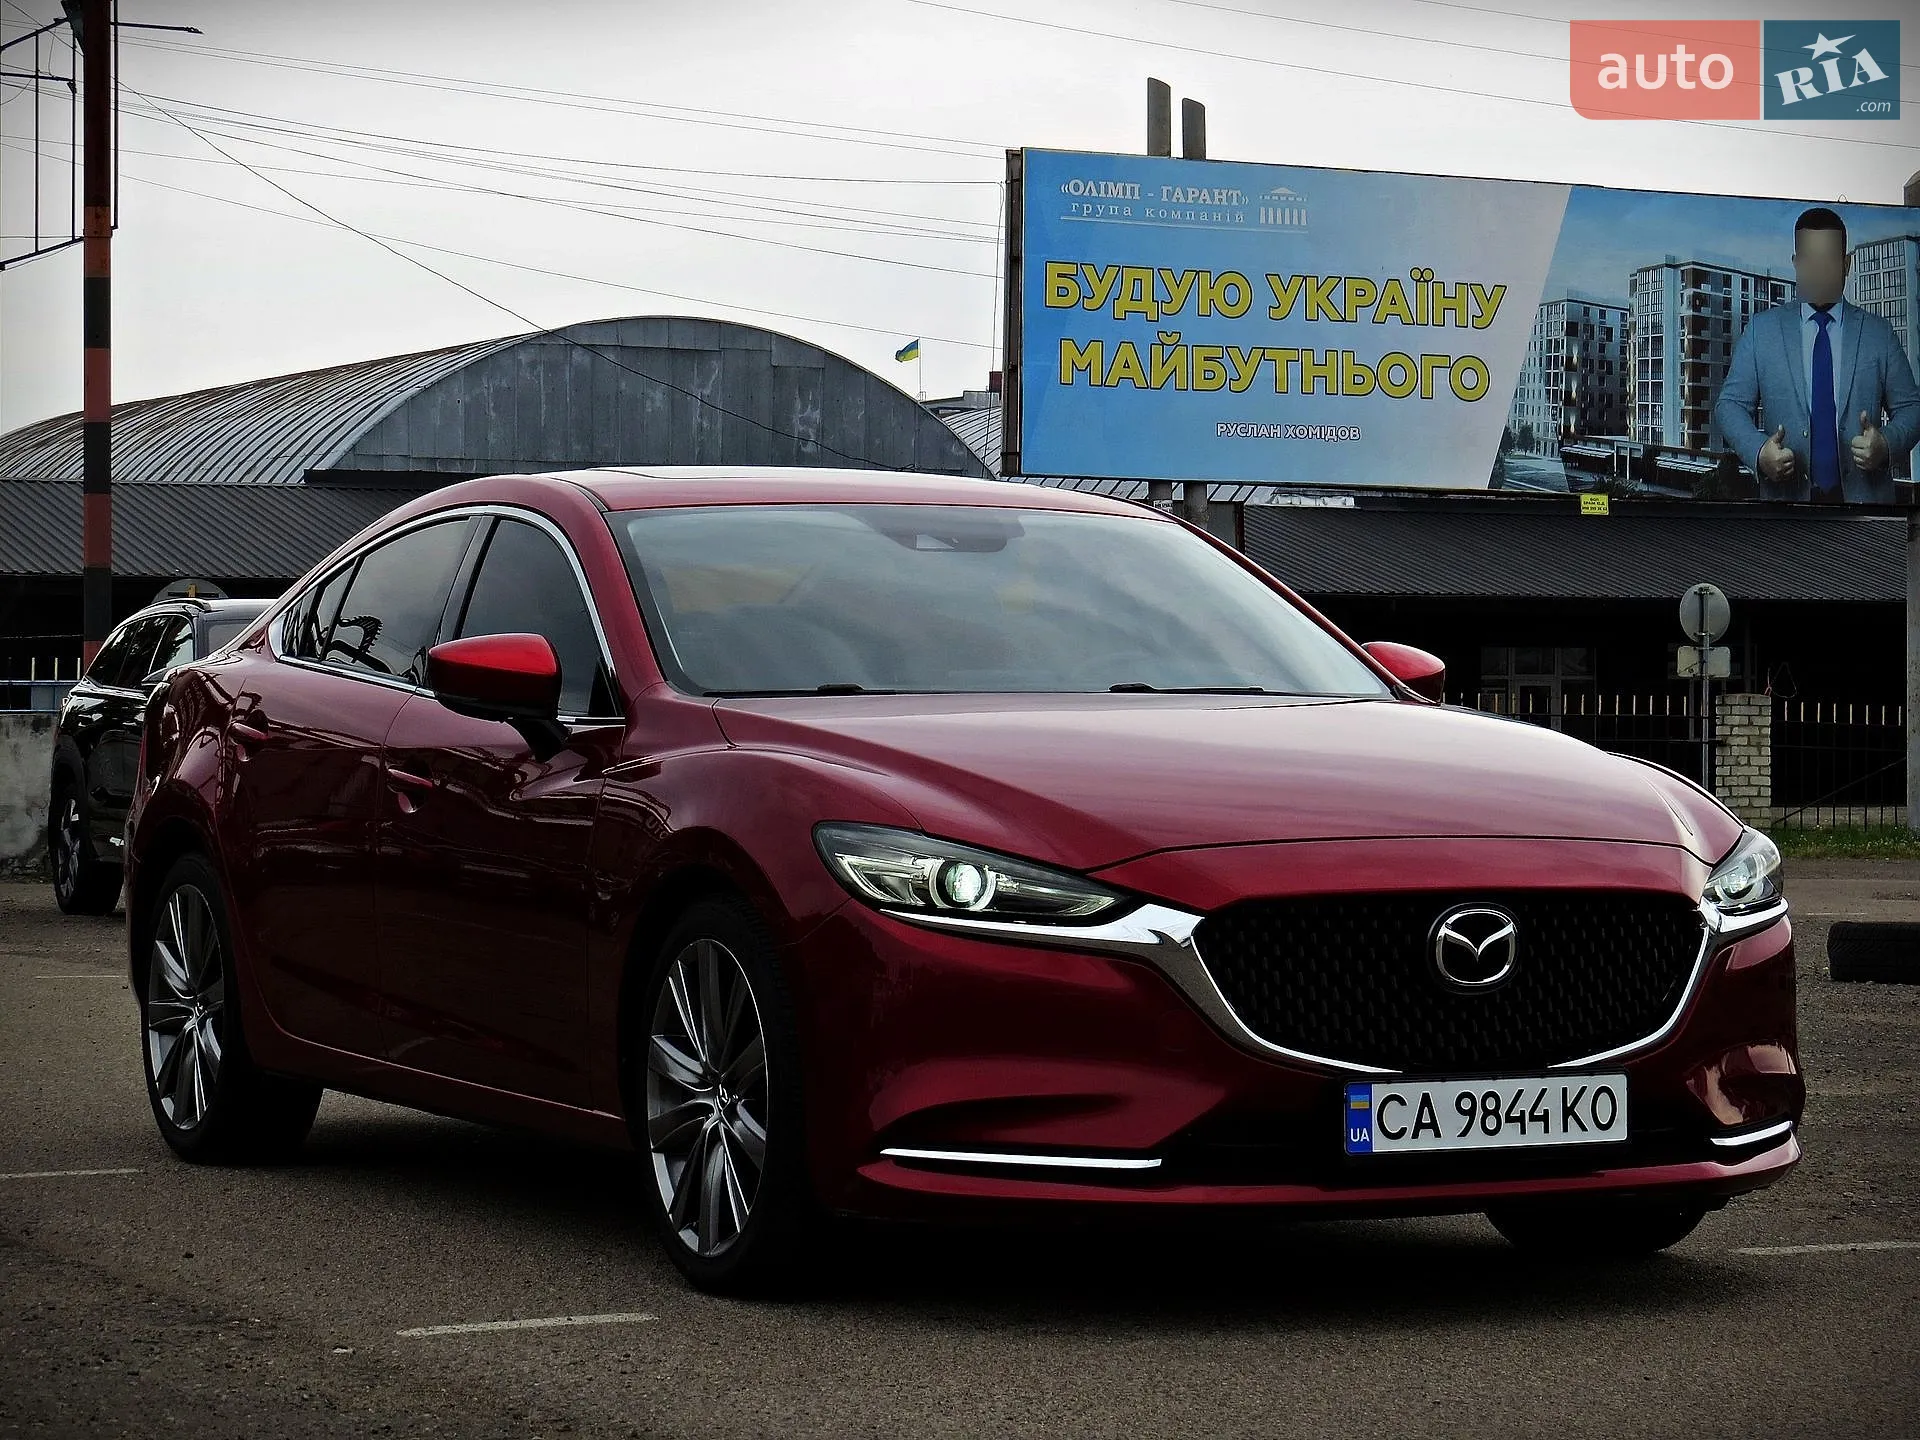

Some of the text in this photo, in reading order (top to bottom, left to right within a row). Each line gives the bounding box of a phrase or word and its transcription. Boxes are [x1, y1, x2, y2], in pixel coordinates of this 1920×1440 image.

[1060, 179, 1141, 200] «ОЛІМП
[1161, 185, 1249, 206] ГАРАНТ»
[1071, 203, 1245, 223] група компаній
[1045, 261, 1507, 329] БУДУЮ УКРАЇНУ
[1059, 331, 1491, 402] МАЙБУТНЬОГО
[1217, 423, 1361, 442] РУСЛАН ХОМІДОВ
[1376, 1091, 1442, 1140] CA
[1455, 1087, 1550, 1138] 9844
[1350, 1127, 1370, 1142] UA
